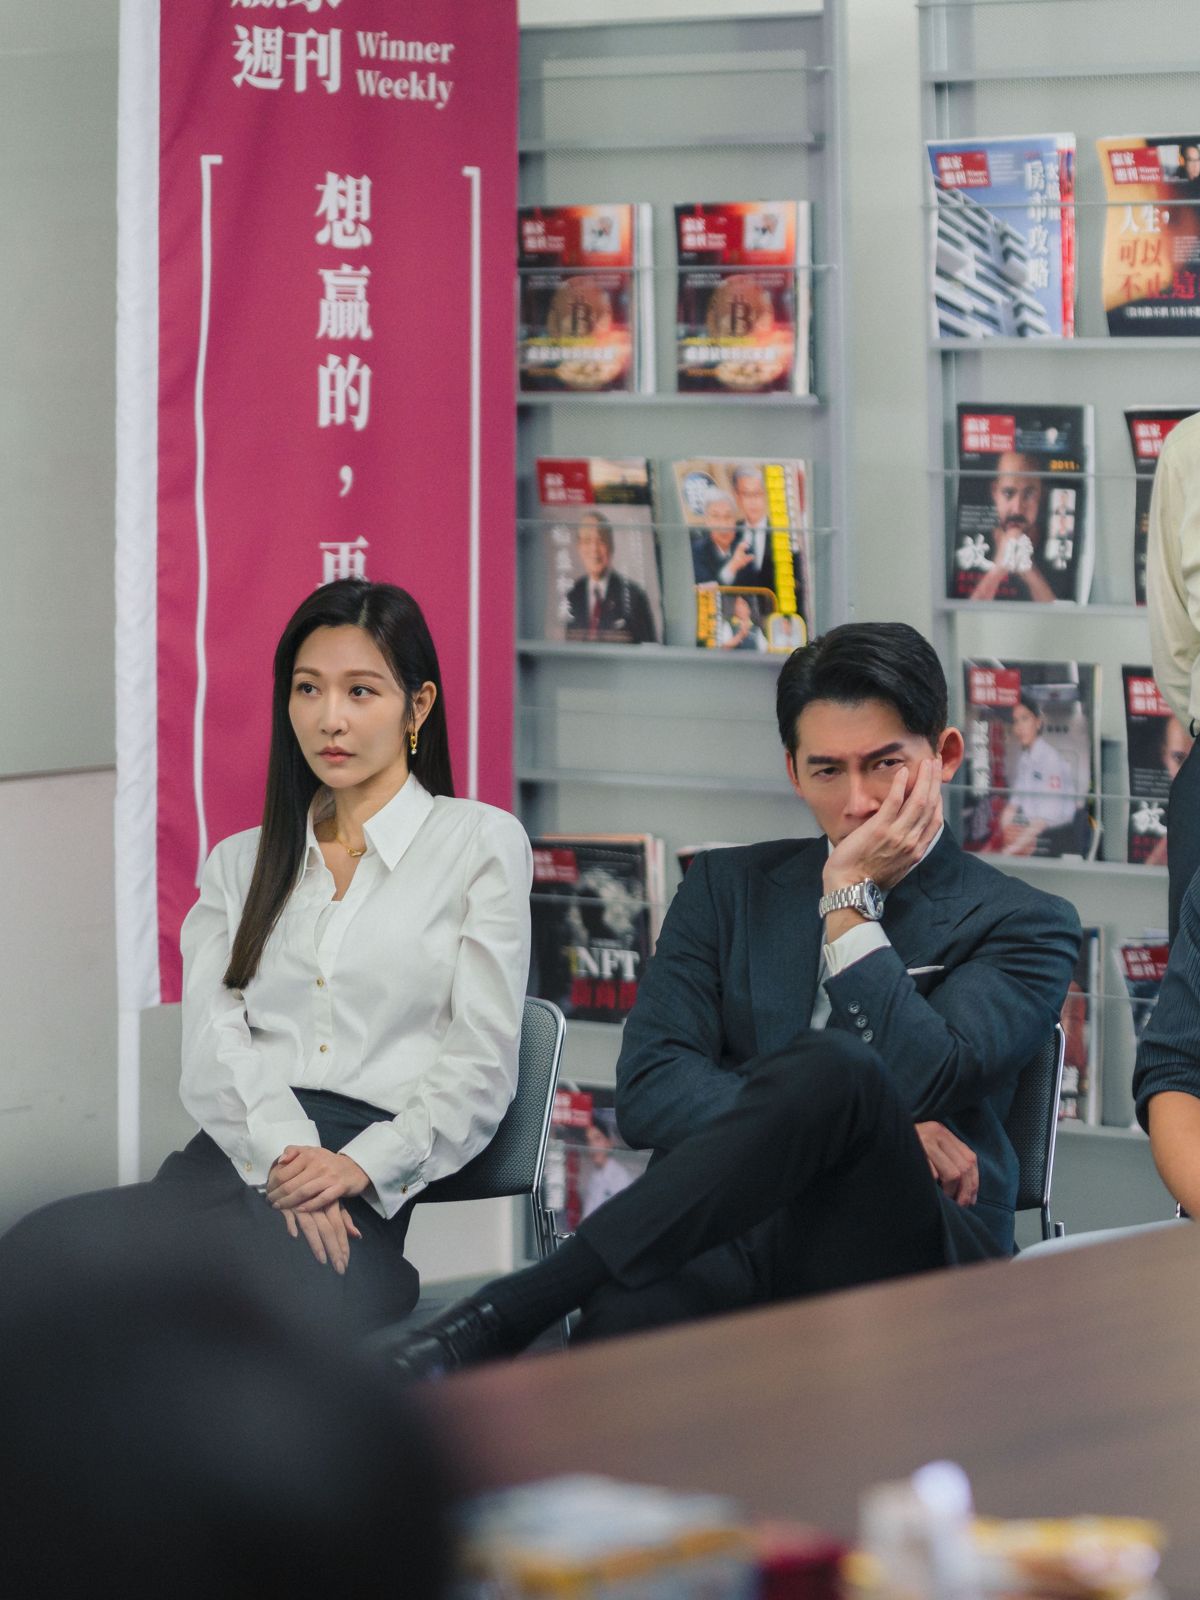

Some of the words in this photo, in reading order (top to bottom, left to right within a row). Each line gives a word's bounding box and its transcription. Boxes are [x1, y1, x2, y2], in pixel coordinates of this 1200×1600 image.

[232, 24, 342, 94] 週刊
[356, 31, 455, 64] Winner
[356, 69, 454, 110] Weekly
[1120, 239, 1162, 267] 可以
[574, 945, 640, 982] NFT
